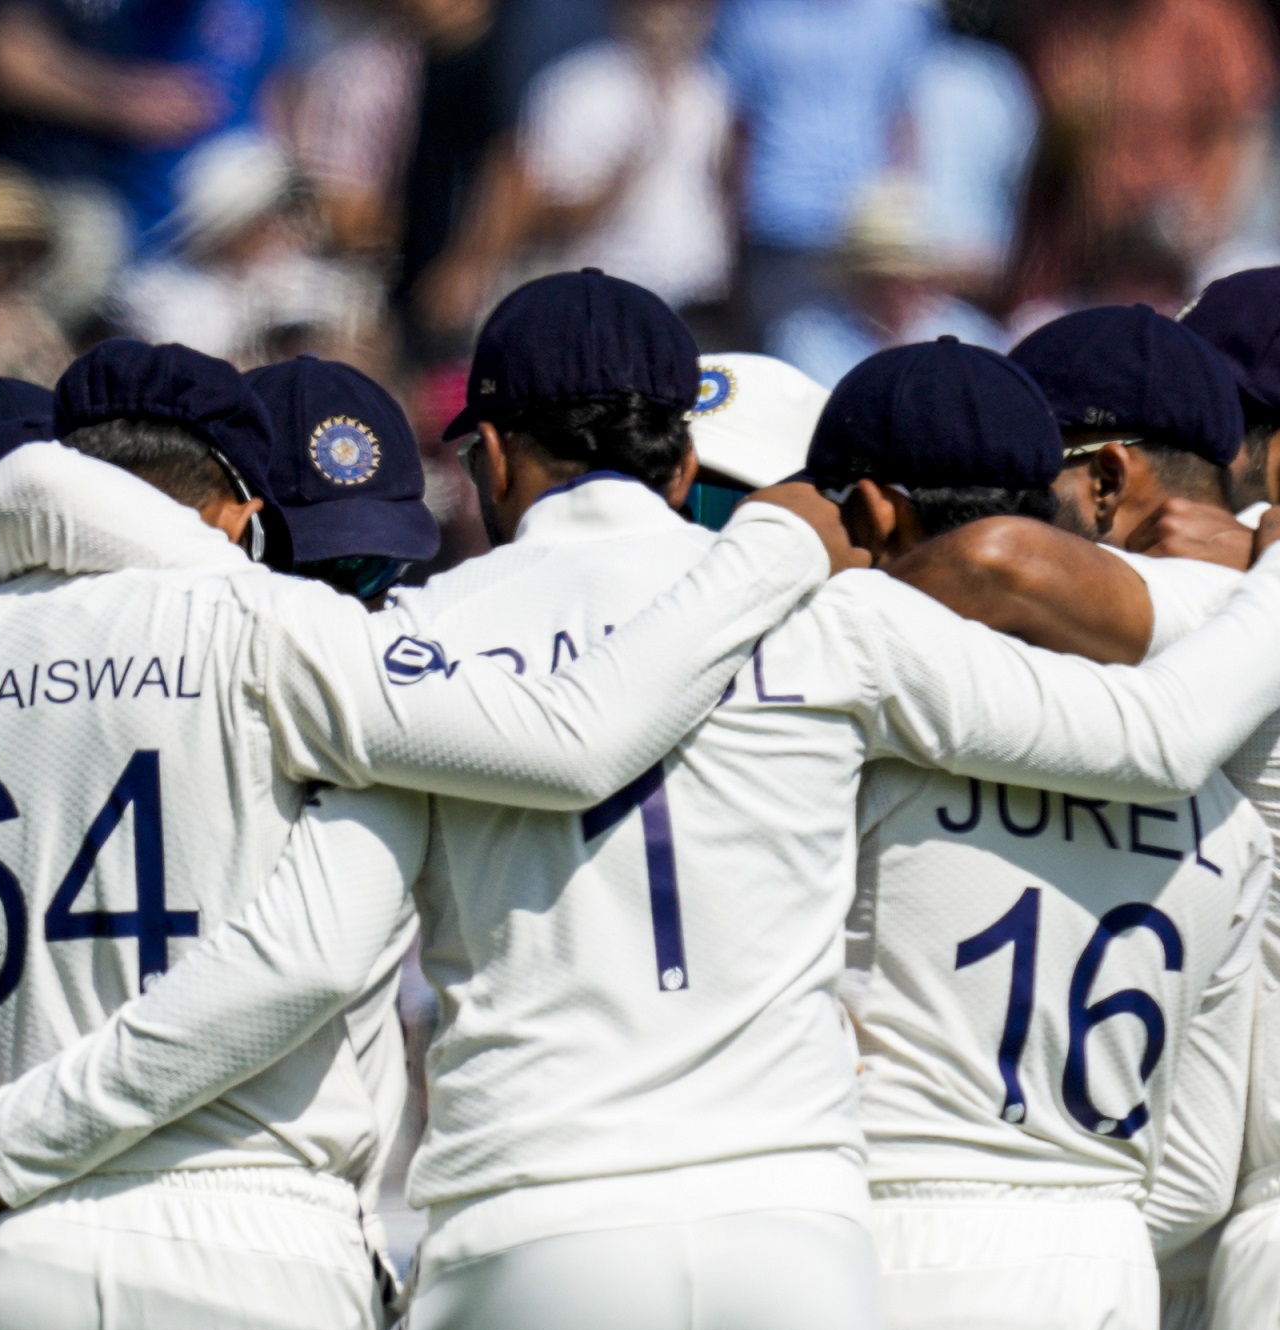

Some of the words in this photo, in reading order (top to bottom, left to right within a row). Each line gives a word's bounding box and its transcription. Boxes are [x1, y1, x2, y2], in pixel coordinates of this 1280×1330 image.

[583, 760, 689, 992] 1
[935, 776, 1223, 877] JUREL
[954, 886, 1185, 1140] 16
